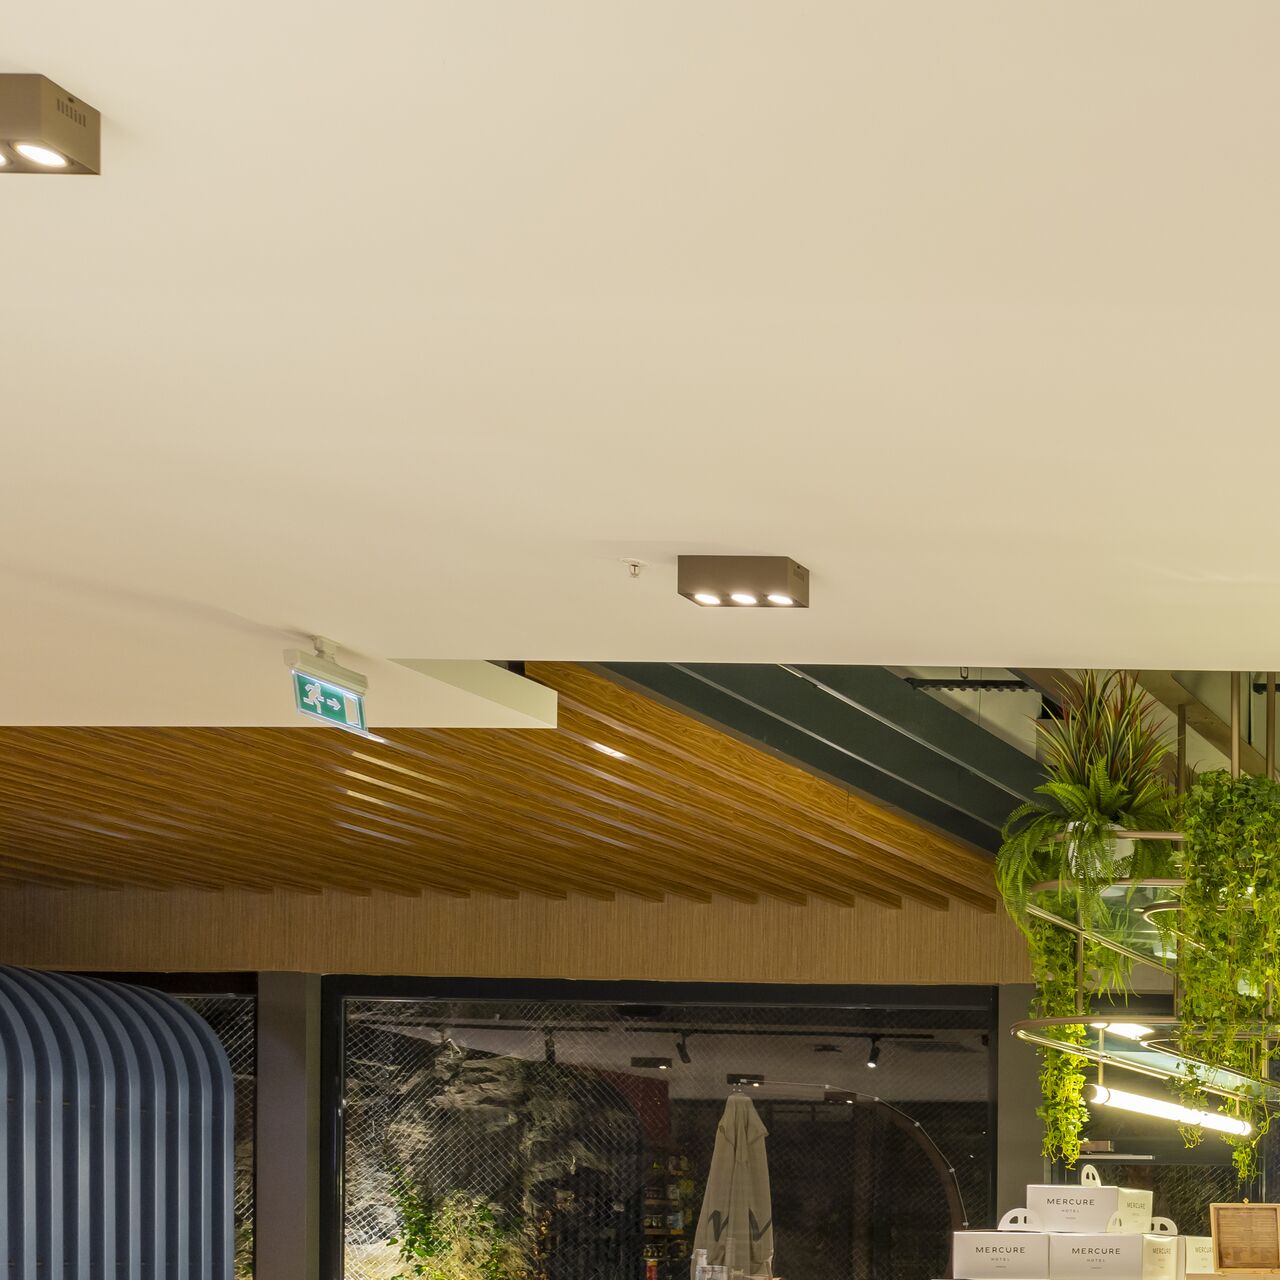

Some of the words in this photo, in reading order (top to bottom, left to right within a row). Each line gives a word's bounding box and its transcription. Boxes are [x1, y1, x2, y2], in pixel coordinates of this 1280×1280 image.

[1046, 1198, 1095, 1206] MERCURE
[975, 1246, 1025, 1254] MERCURE
[1071, 1247, 1121, 1255] MERCURE
